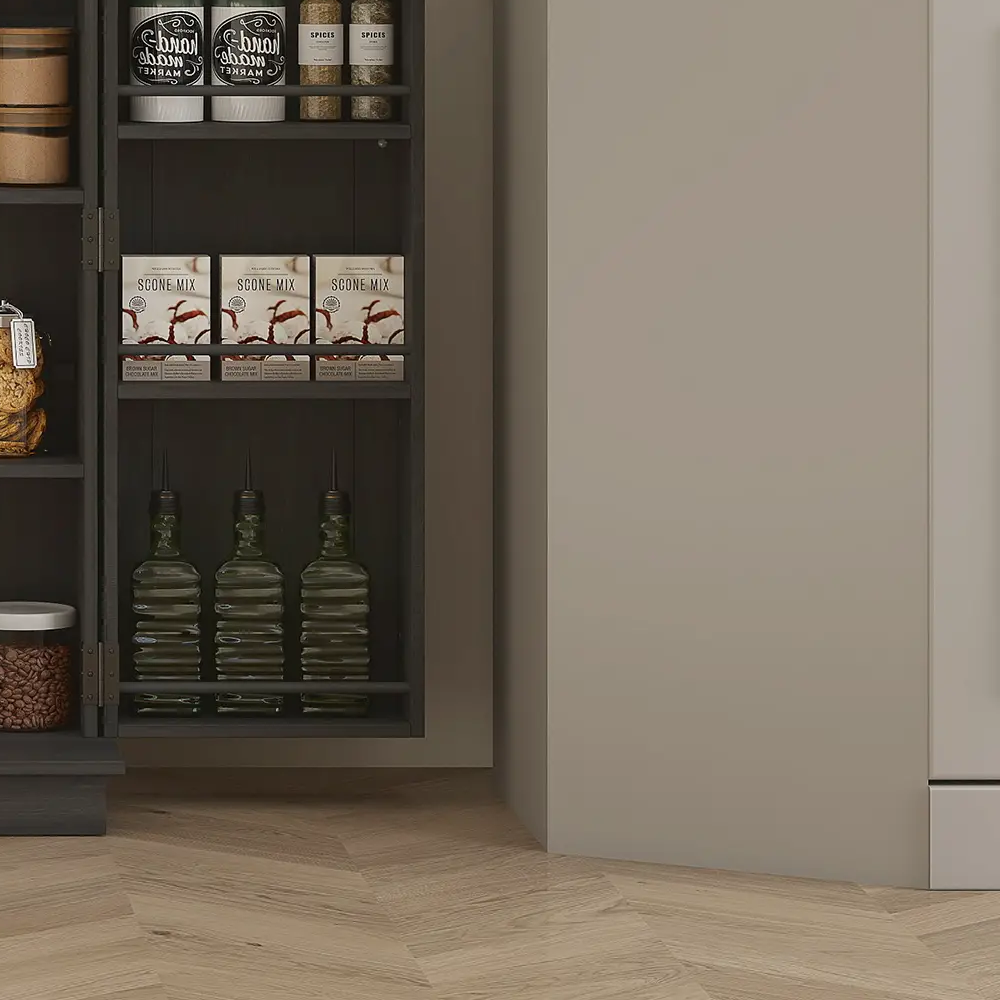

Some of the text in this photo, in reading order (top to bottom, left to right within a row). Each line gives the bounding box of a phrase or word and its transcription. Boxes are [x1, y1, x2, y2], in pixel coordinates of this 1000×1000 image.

[138, 279, 196, 291] SCONE MIX
[238, 279, 295, 291] SCONE MIX
[332, 279, 389, 291] SCONE MIX
